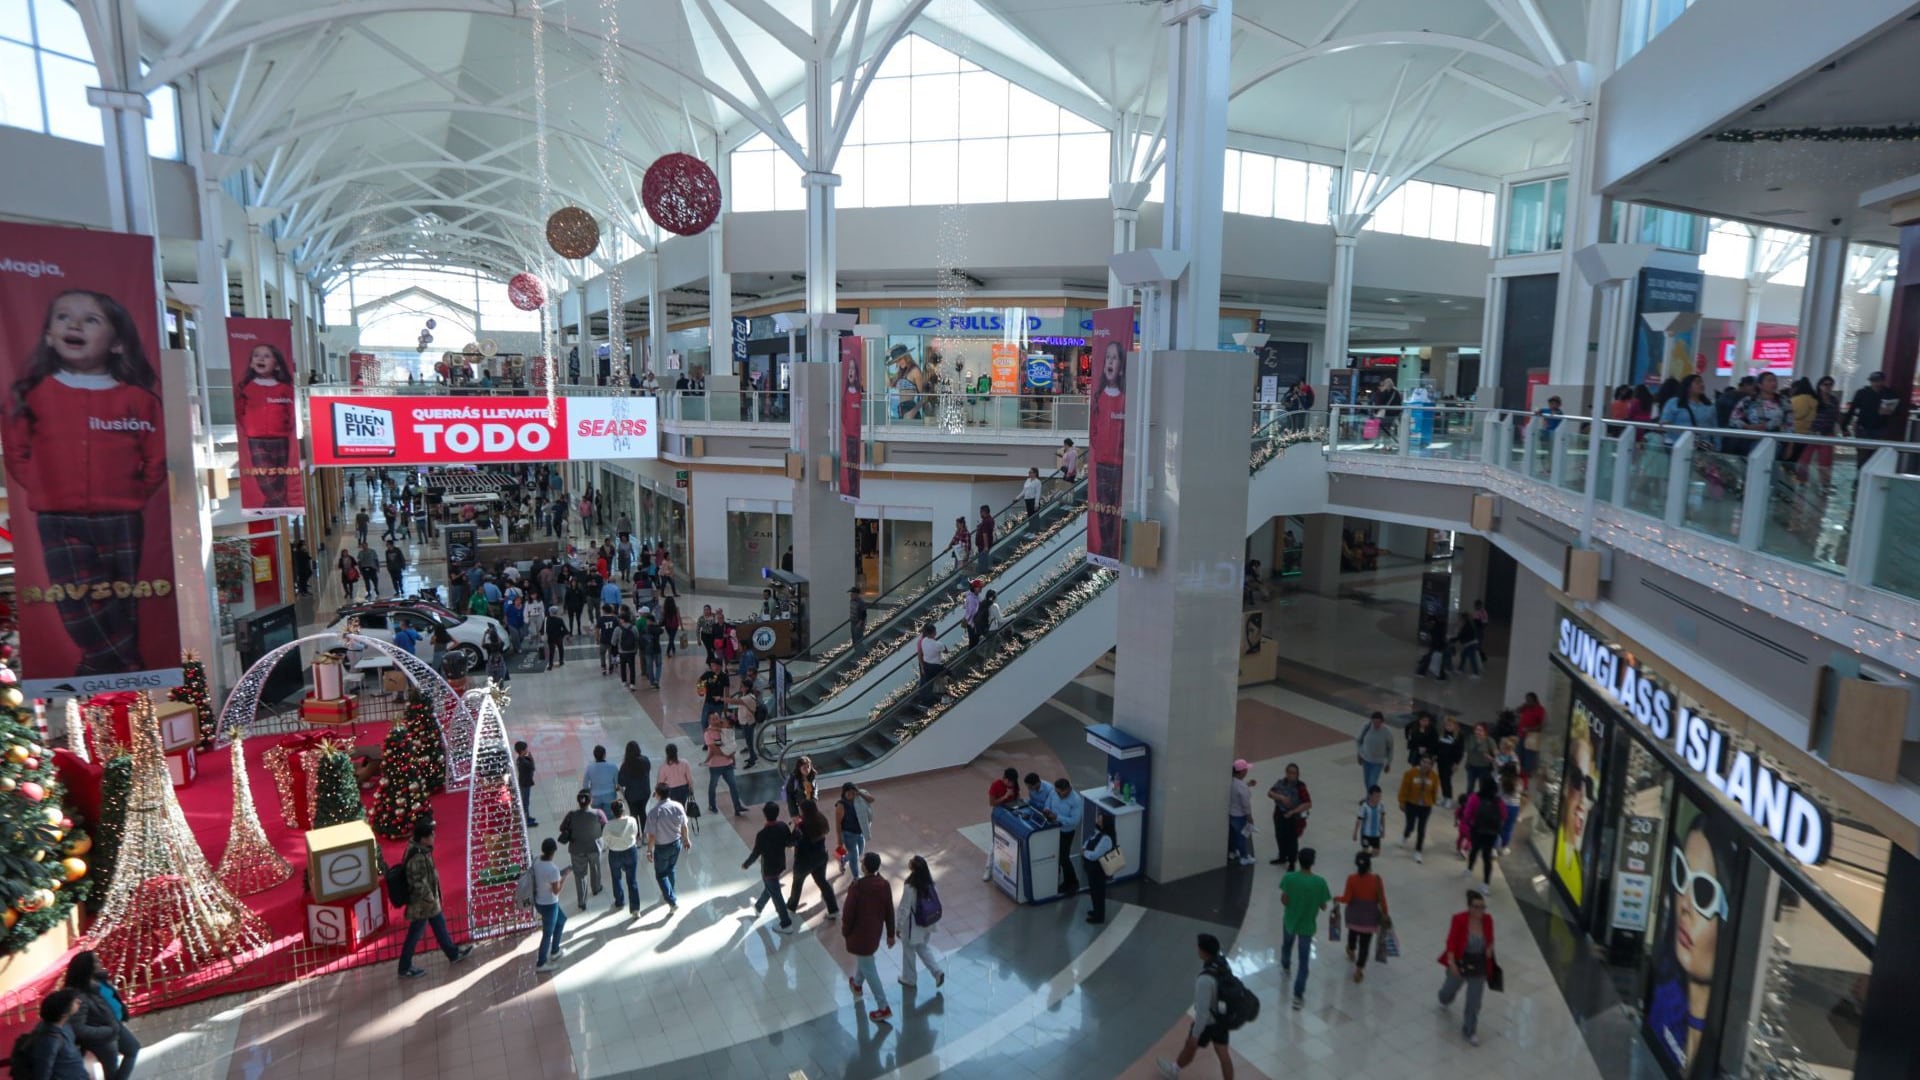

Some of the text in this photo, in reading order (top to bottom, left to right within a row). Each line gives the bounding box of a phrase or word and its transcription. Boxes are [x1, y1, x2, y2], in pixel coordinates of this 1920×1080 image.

[734, 318, 747, 359] telcel
[344, 412, 385, 426] BUEN
[412, 407, 550, 419] QUERRÁS LLEVARTE
[413, 423, 551, 454] TODO
[577, 419, 647, 437] SEARS
[460, 484, 501, 494] GLOBO
[1559, 618, 1822, 865] SUNGLASS ISLAND
[328, 853, 362, 887] e
